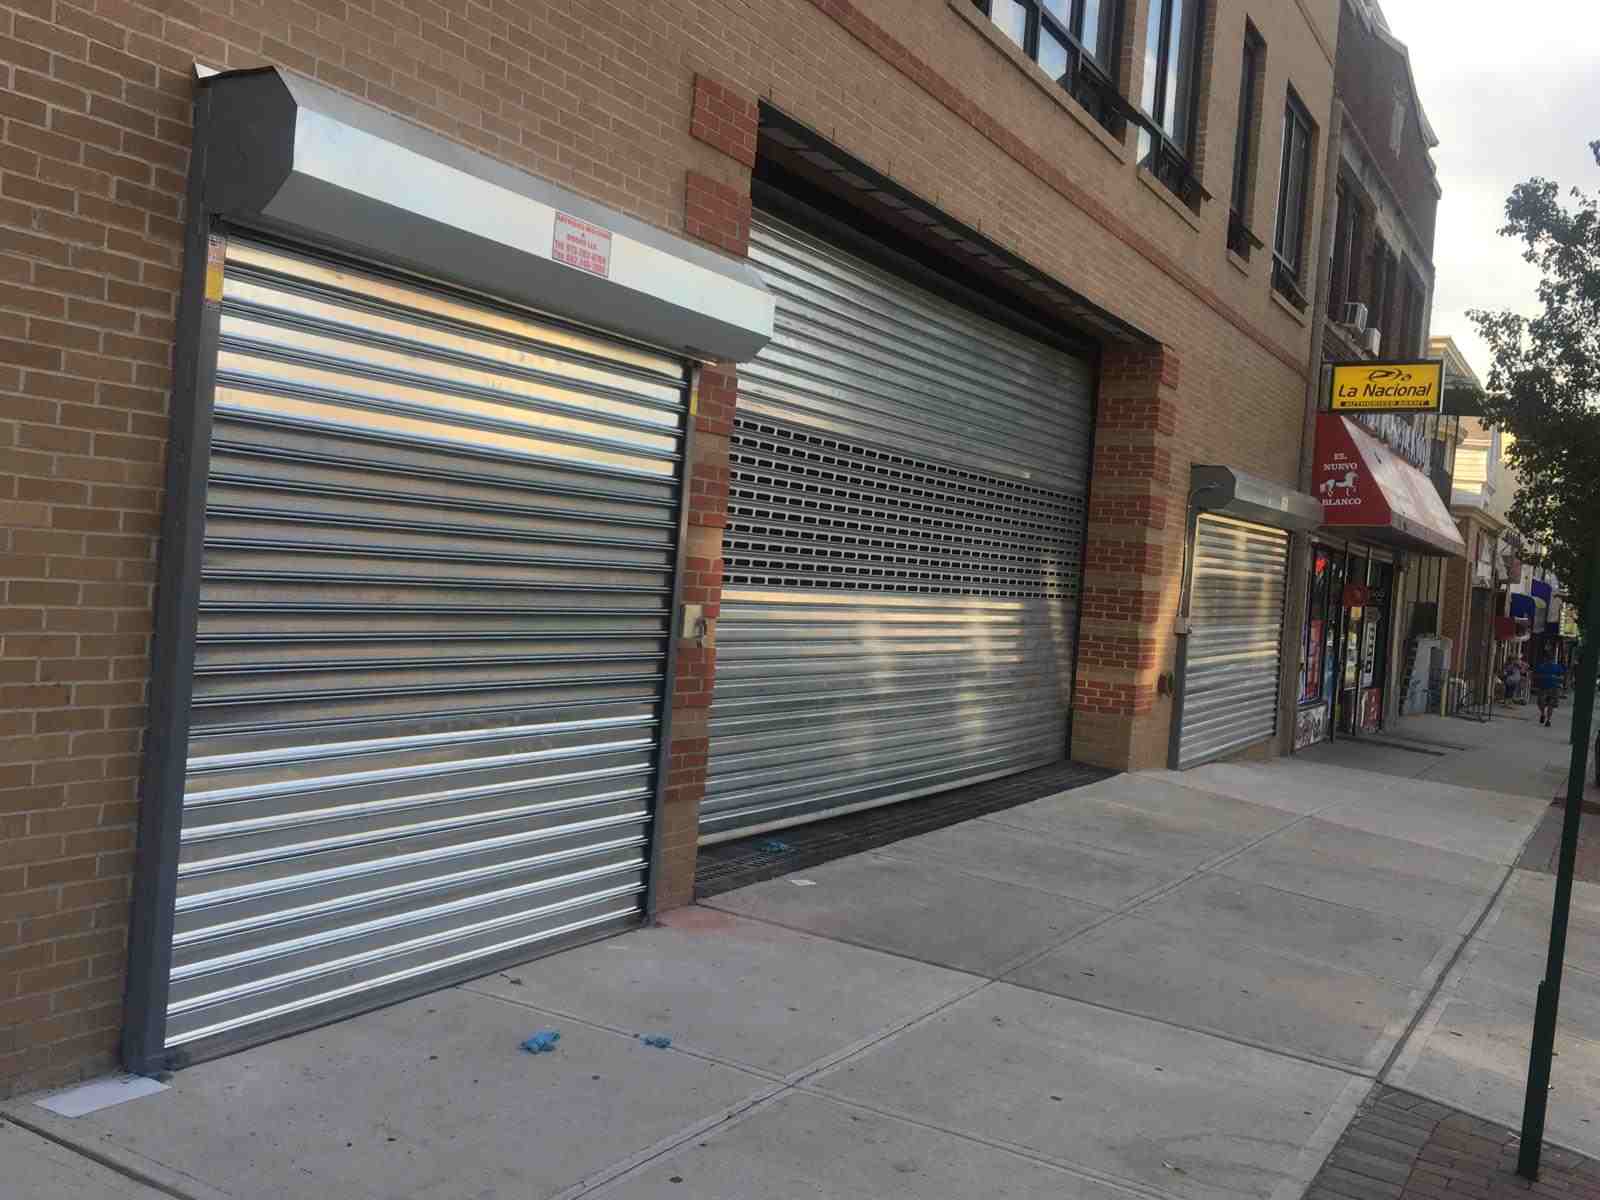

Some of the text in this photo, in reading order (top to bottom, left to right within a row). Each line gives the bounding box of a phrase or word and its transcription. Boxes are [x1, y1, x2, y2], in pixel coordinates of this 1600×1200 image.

[1338, 381, 1433, 398] La Nacional
[1323, 463, 1358, 471] NUEVO
[1321, 496, 1362, 506] BLANCO
